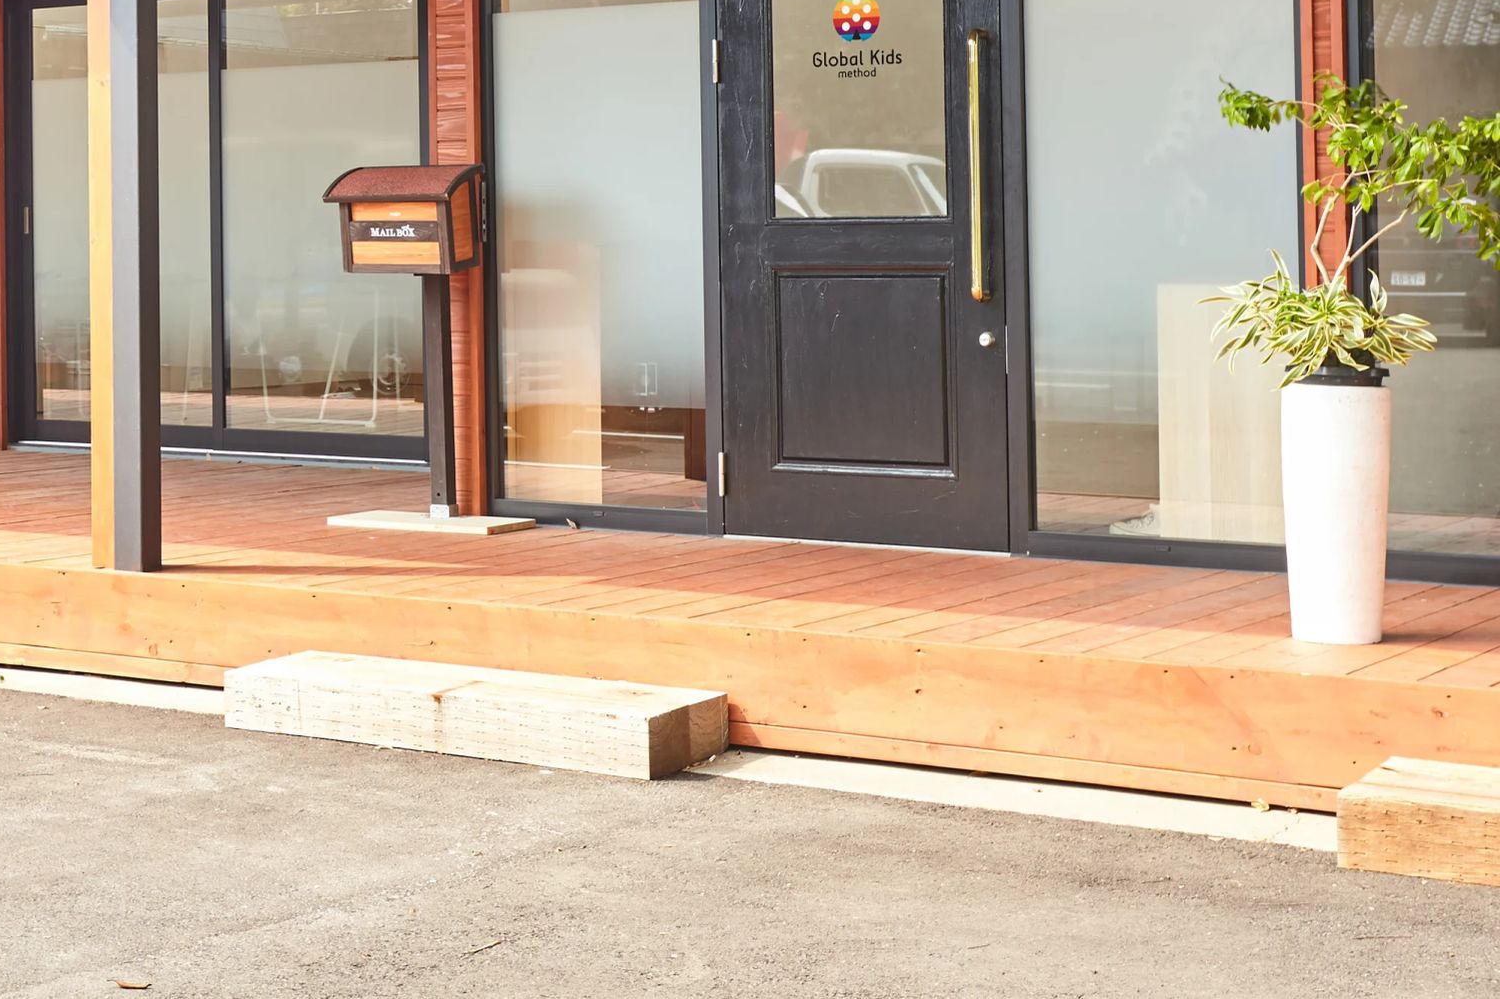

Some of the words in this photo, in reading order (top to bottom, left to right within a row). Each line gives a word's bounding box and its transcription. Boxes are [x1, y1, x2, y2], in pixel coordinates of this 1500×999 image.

[812, 50, 863, 68] Global
[870, 49, 902, 65] Kids
[838, 67, 877, 78] method
[370, 227, 396, 237] MAIL
[396, 226, 416, 237] BOX
